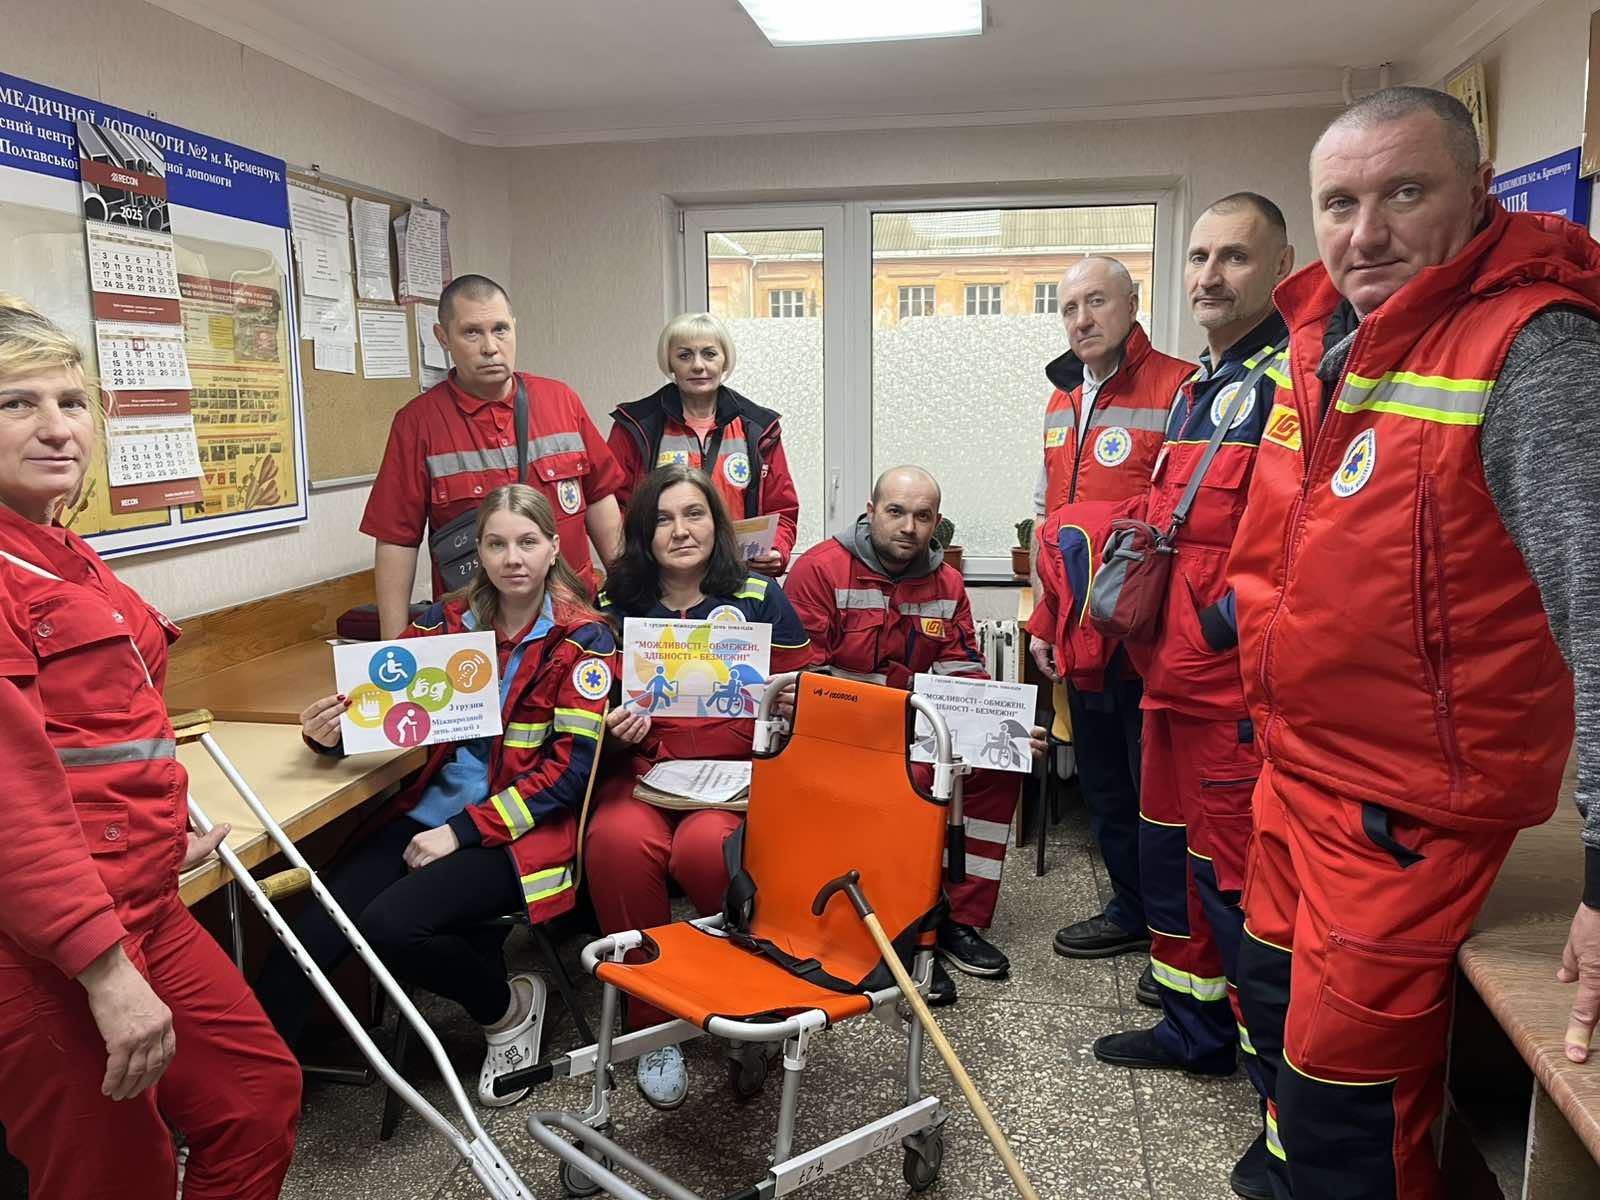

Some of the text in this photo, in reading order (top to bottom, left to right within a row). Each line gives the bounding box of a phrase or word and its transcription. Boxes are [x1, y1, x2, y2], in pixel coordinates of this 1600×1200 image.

[37, 126, 76, 150] центр
[185, 168, 233, 188] допомоги
[187, 142, 208, 160] №2
[210, 153, 222, 165] м.
[224, 152, 280, 183] Кременчук
[120, 206, 143, 221] 2025
[644, 652, 692, 661] ЗДІБНОСТІ
